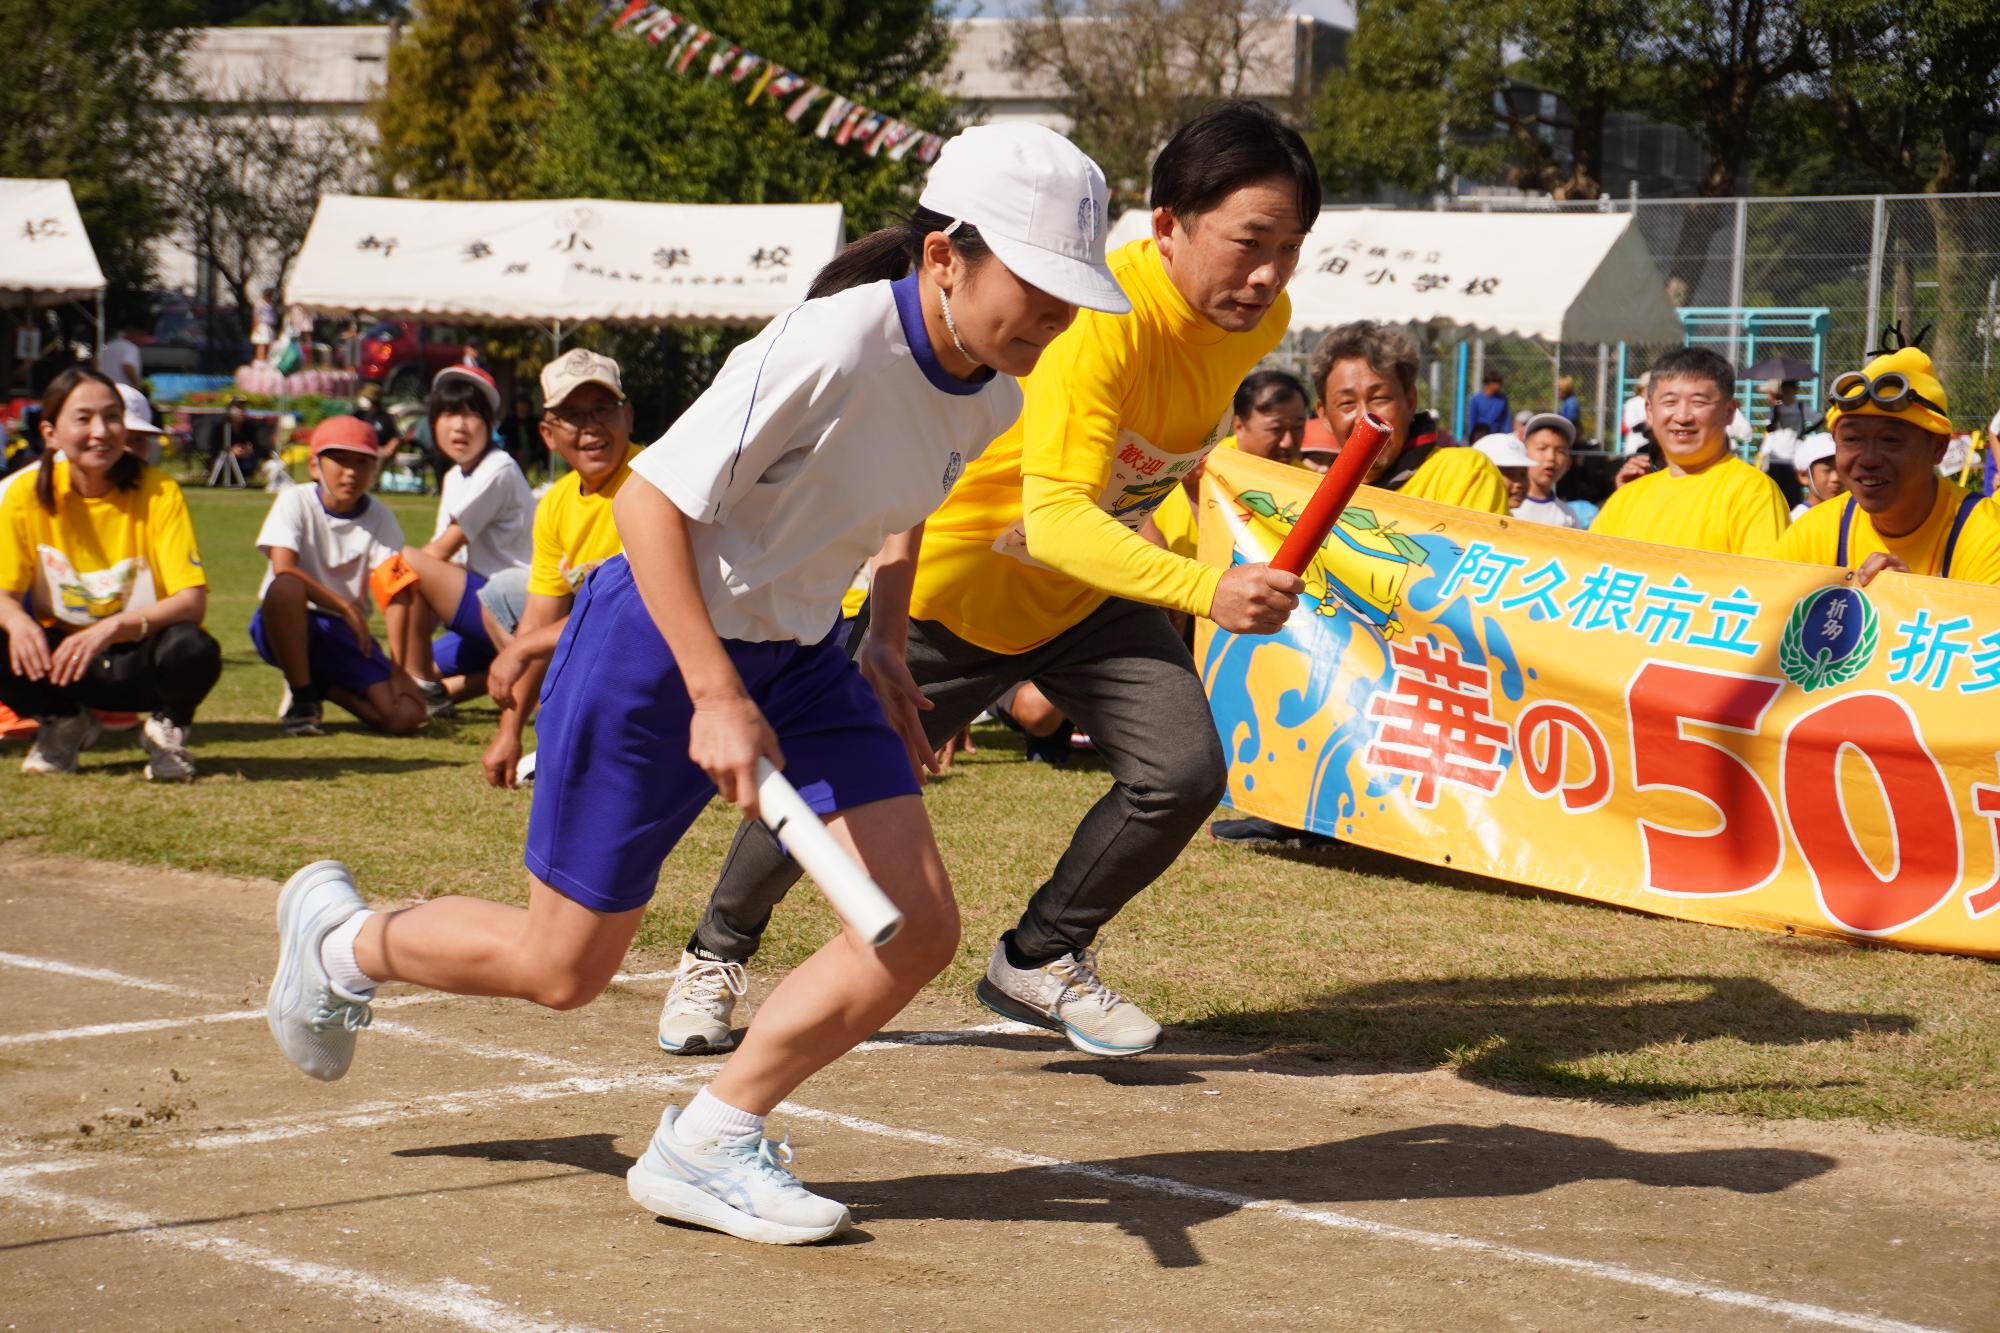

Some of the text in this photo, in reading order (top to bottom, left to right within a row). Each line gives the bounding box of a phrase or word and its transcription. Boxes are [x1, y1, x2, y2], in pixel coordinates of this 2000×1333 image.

[1439, 542, 1761, 655] 阿久根市立
[1822, 598, 1849, 640] 折多
